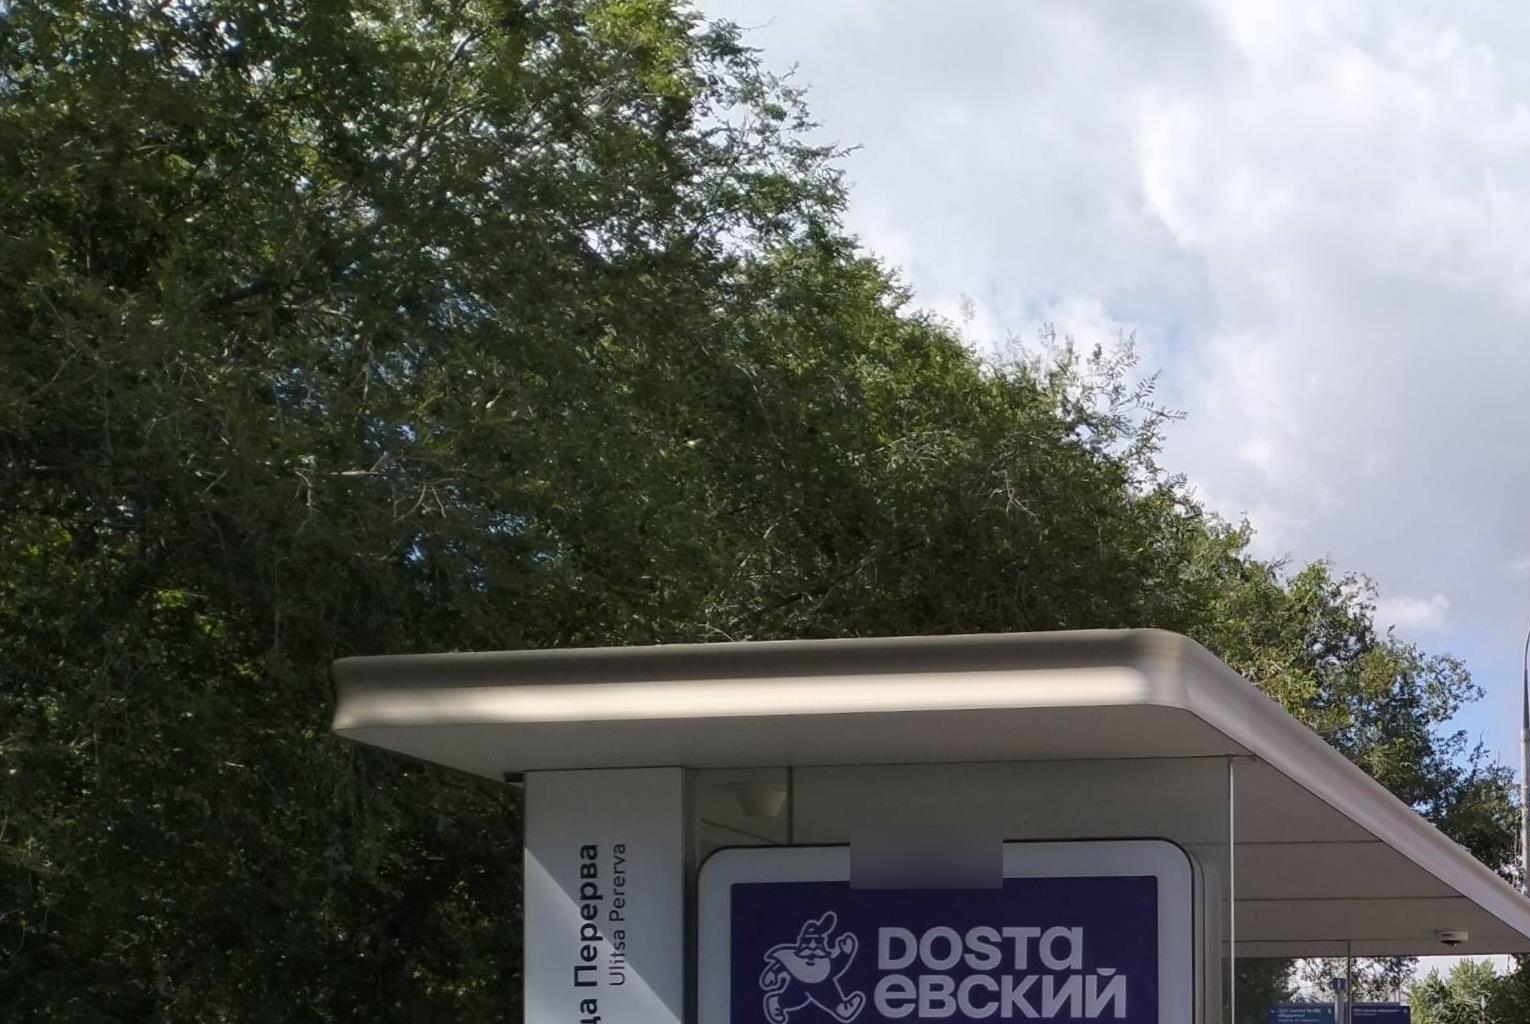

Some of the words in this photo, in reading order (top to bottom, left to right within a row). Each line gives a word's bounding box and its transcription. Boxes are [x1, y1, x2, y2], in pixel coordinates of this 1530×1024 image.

[574, 844, 604, 987] Перерва
[609, 842, 626, 922] Pererva
[609, 929, 625, 986] Ulitsa
